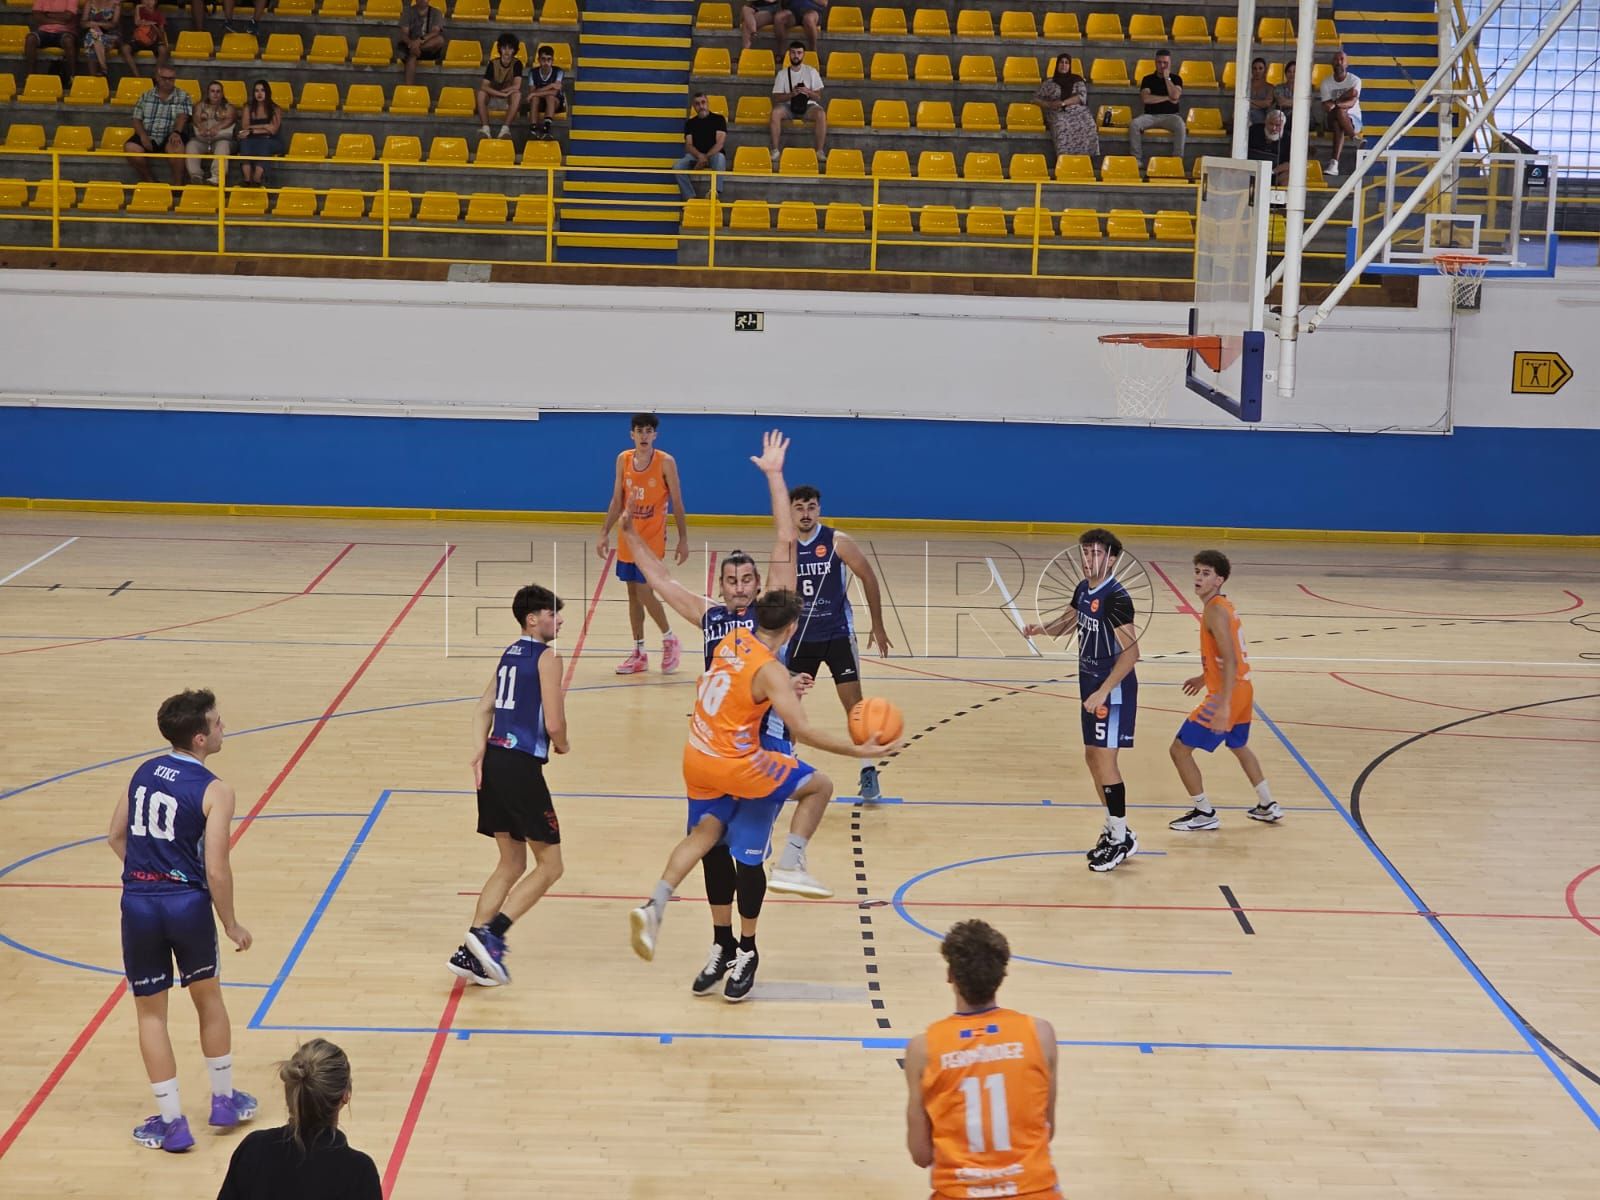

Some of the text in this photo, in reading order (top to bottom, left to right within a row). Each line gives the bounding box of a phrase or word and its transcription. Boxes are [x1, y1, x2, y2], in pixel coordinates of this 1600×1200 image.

[802, 579, 815, 597] 6
[495, 665, 517, 710] 11
[1095, 722, 1107, 741] 5
[153, 764, 180, 782] KIKE
[130, 785, 179, 842] 10
[958, 1072, 1013, 1153] 11
